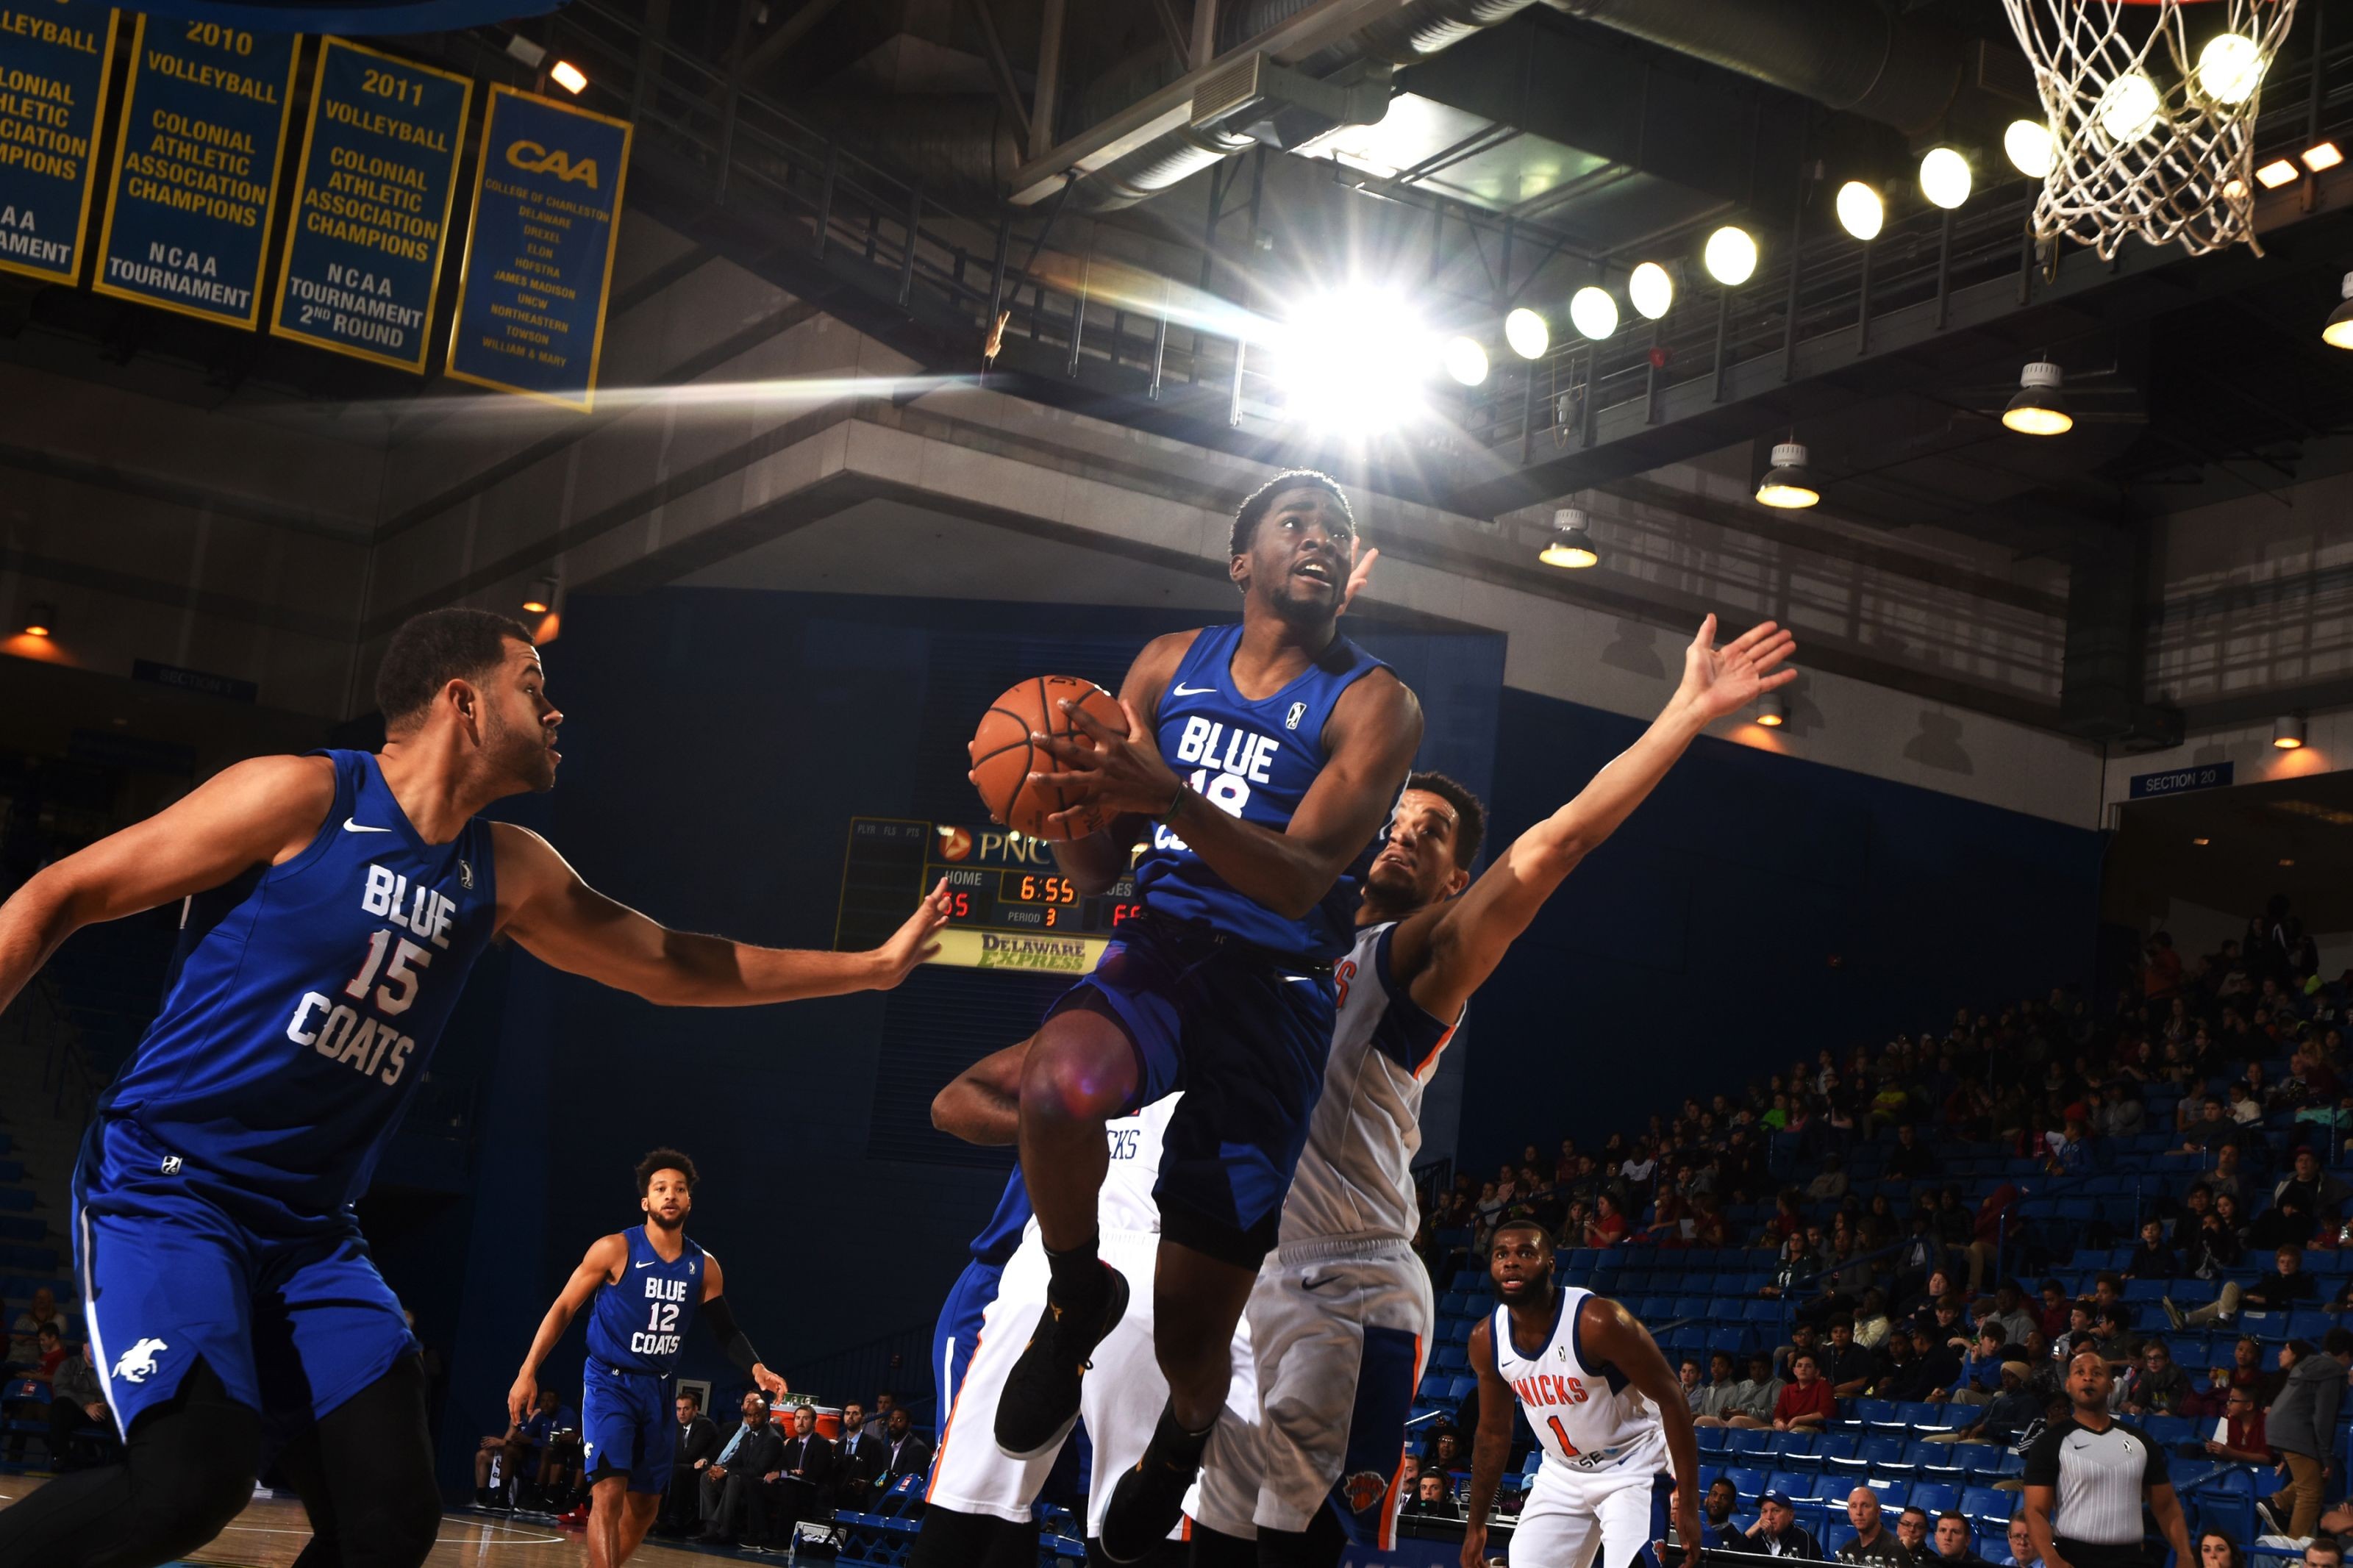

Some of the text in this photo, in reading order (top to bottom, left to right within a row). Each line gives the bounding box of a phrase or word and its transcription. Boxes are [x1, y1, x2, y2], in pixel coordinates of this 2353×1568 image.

[0, 10, 97, 54] LEYBALL
[186, 21, 253, 56] 2010
[149, 50, 277, 104] VOLLEYBALL
[362, 68, 424, 107] 2011
[152, 110, 256, 154] COLONIAL
[326, 99, 448, 153] VOLLEYBALL
[150, 134, 251, 176] ATHLETIC
[330, 147, 428, 191] COLONIAL
[505, 140, 599, 189] CAA
[125, 152, 267, 206] ASSOCIATION
[328, 171, 422, 212] ATHLETIC
[128, 176, 257, 227] CHAMPIONS
[304, 188, 438, 240] ASSOCIATION
[485, 178, 610, 223] COLLEGE OF CHARLESTON
[518, 205, 573, 229] DELAWARE
[307, 212, 429, 262] CHAMPIONS
[523, 223, 561, 245] DREXEL
[526, 243, 554, 259] ELON
[149, 242, 217, 276] NCAA
[515, 257, 560, 278] HOFSTRA
[110, 257, 251, 309] TOURNAMENT
[327, 262, 393, 298] NCAA
[493, 269, 576, 300] JAMES MADISON
[290, 277, 424, 329] TOURNAMENT
[518, 292, 549, 309] UNCW
[300, 304, 404, 348] 2ND ROUND
[490, 304, 569, 334] NORTHEASTERN
[506, 324, 550, 346] TOWSON
[482, 337, 526, 359] WILLIAM
[538, 351, 567, 368] MARY
[1177, 715, 1279, 784] BLUE
[2146, 770, 2216, 792] SECTION 20
[857, 824, 920, 838] PLYR FLS PTS
[979, 831, 1051, 865] PNC
[945, 870, 982, 887] HOME
[1020, 876, 1075, 903] 6:55
[362, 863, 456, 949] BLUE
[1008, 912, 1040, 923] PERIOD
[1045, 907, 1057, 927] 3
[344, 929, 432, 1017] 15
[976, 951, 1086, 971] EXPRESS
[287, 991, 415, 1086] COATS
[645, 1277, 687, 1302] BLUE
[648, 1302, 680, 1332] 12
[631, 1331, 681, 1355] COATS
[1547, 1415, 1580, 1457] 1
